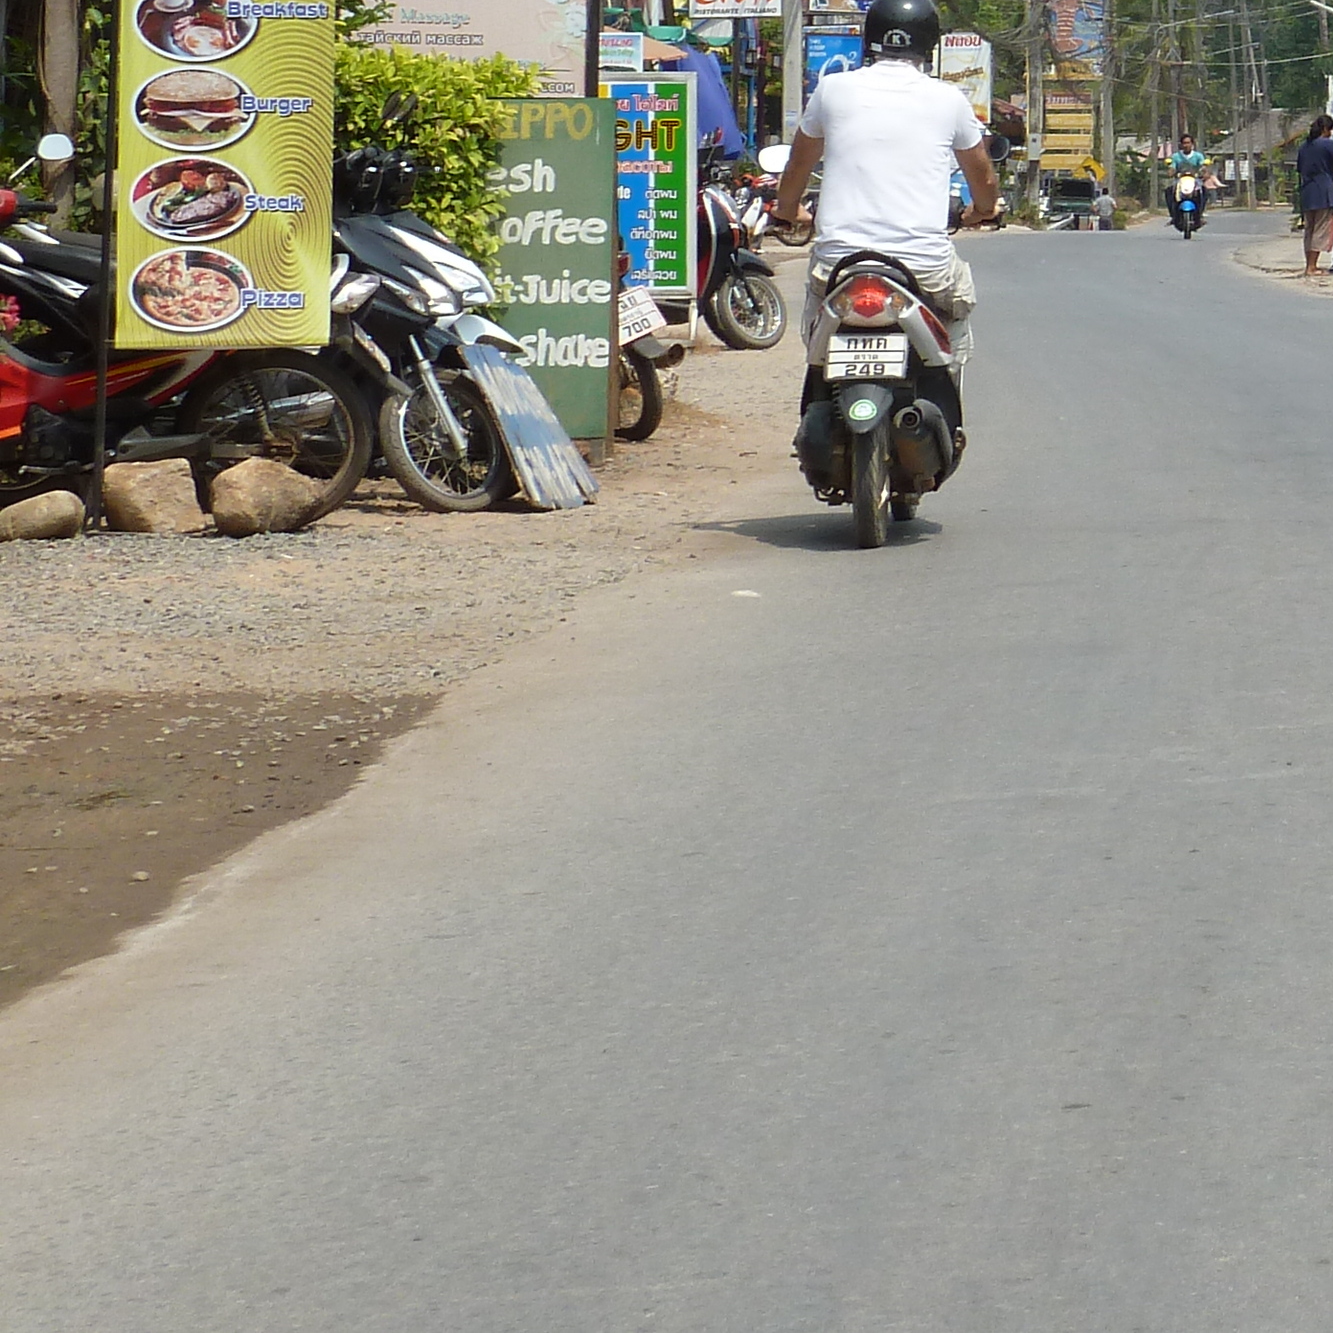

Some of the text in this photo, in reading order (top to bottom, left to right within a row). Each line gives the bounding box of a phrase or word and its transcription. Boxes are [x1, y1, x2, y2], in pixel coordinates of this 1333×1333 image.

[227, 1, 329, 19] Breakfast
[357, 29, 484, 46] тайский массаж
[240, 95, 313, 115] Burger
[500, 101, 594, 141] IPPO
[616, 118, 681, 152] GHT
[485, 157, 556, 193] esh
[244, 194, 304, 211] Steak
[501, 208, 608, 246] offee
[241, 289, 304, 309] Pizza
[621, 317, 652, 337] 700
[844, 363, 886, 377] 249
